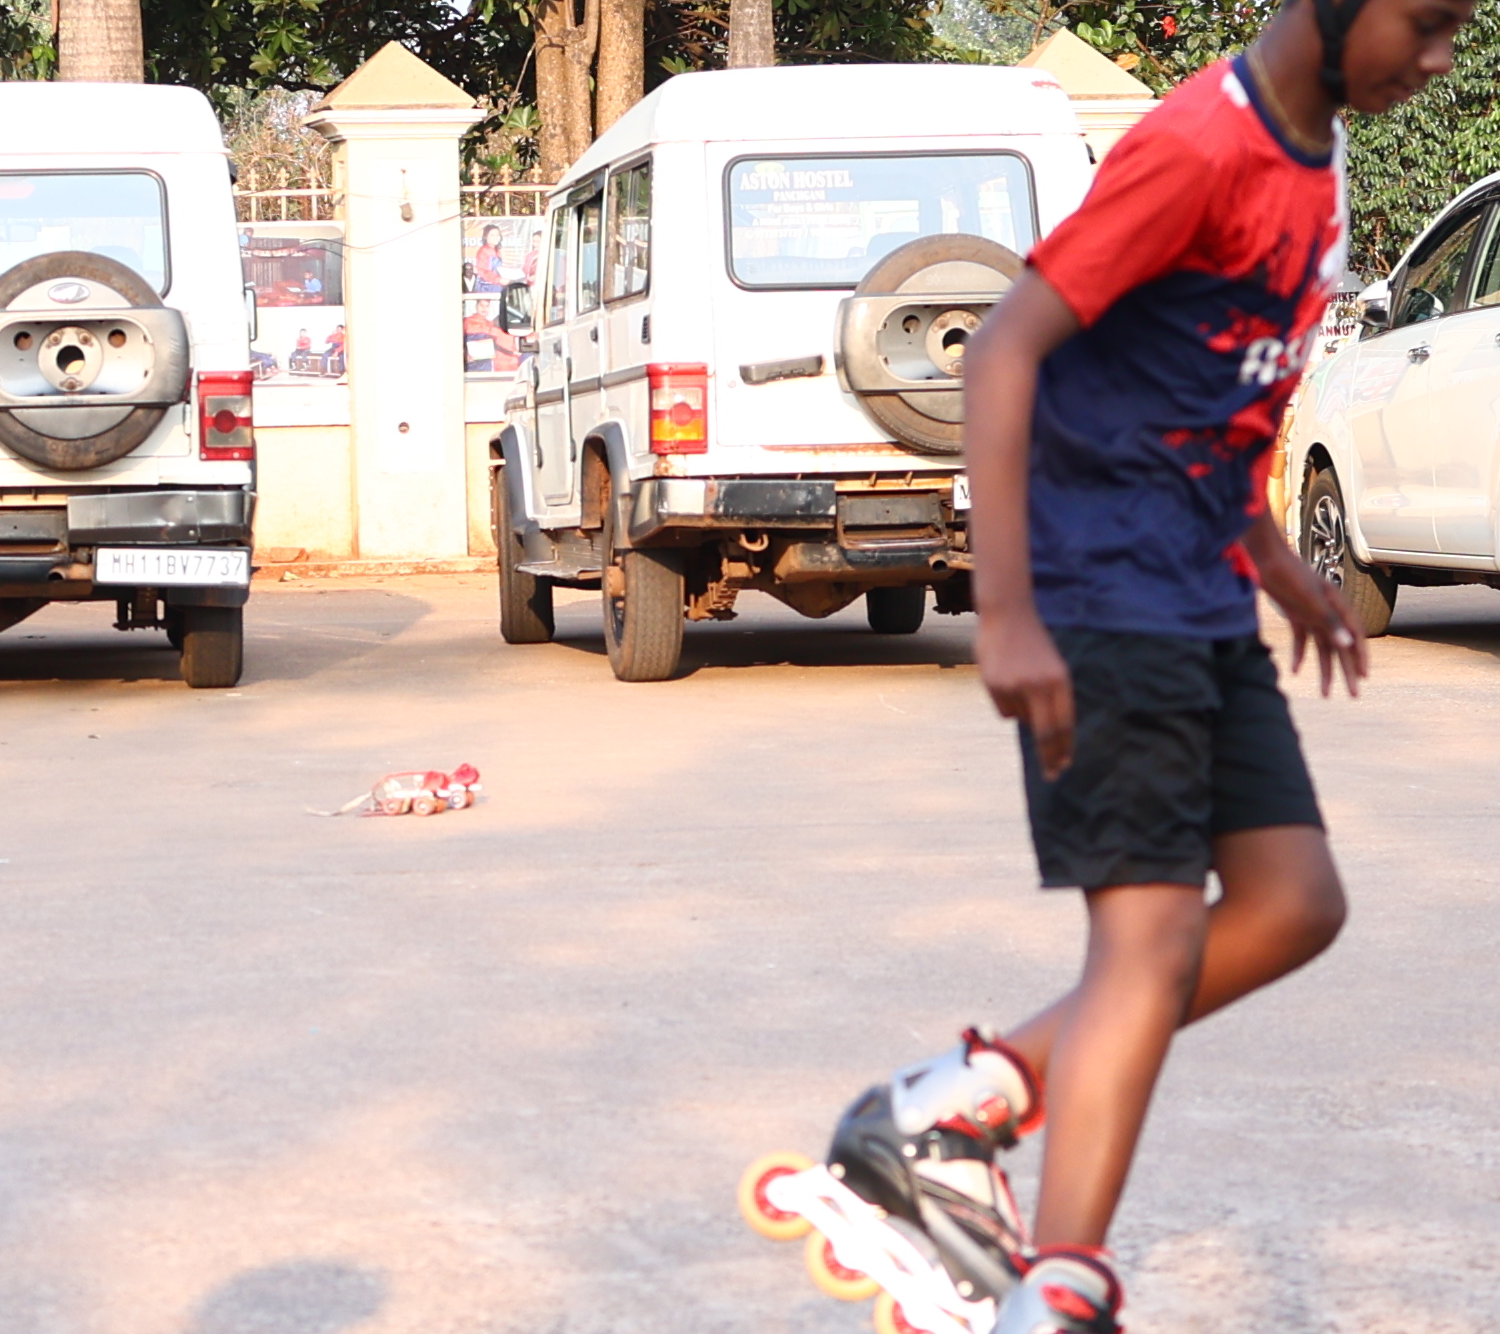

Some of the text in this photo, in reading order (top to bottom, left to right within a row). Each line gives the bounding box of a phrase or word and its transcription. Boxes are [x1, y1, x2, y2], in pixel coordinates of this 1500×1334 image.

[740, 170, 853, 191] ASTON HOSTEL
[112, 554, 242, 576] MH11BV7737
